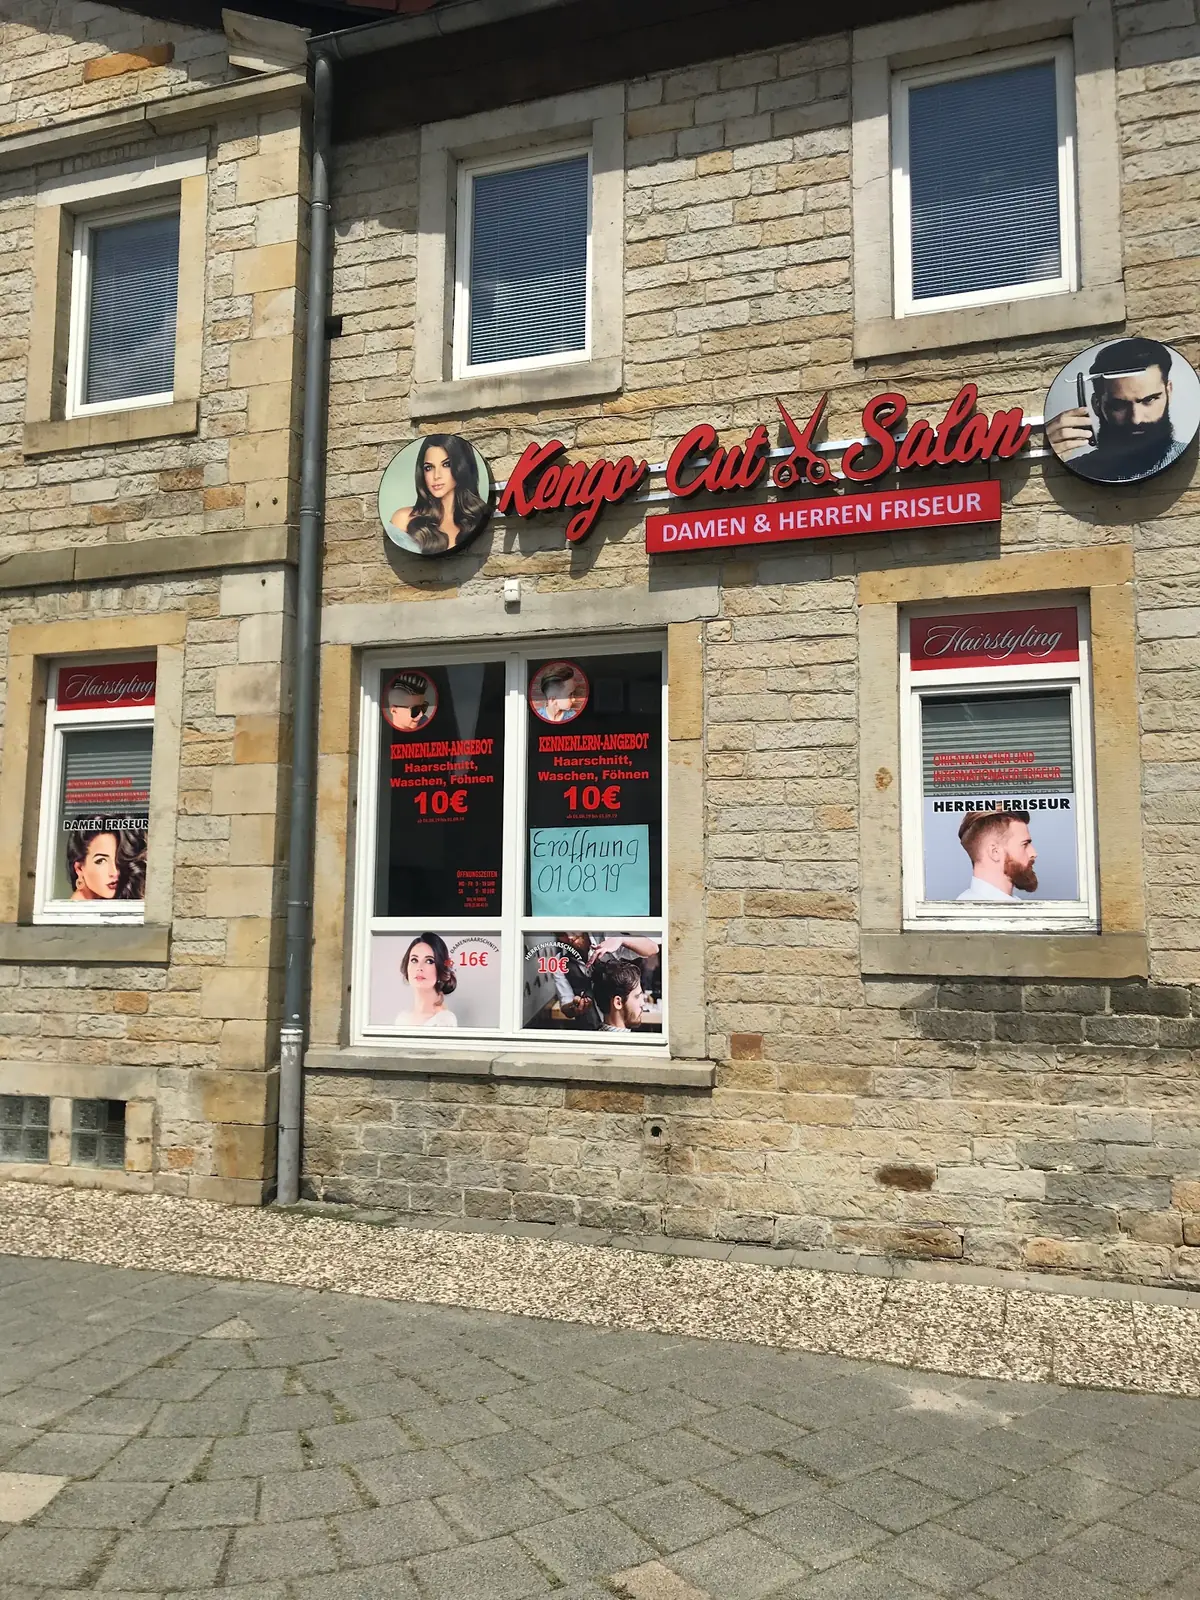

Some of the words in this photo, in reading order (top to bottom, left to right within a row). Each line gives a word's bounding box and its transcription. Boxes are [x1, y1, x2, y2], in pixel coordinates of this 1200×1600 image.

[498, 440, 648, 541] Kengo
[666, 424, 769, 497] Cut
[842, 383, 1032, 482] Salon
[663, 517, 746, 542] DAMEN
[753, 513, 771, 533] &
[779, 504, 872, 530] HERREN
[880, 493, 981, 521] FRISEUR
[924, 625, 1062, 660] Hairstyling
[66, 674, 155, 703] Hairstyling
[390, 739, 494, 759] KENNENLERN-ANGEBOT
[539, 733, 649, 752] KENNENLERN-ANGEBOT
[404, 760, 478, 773] Haarschnitt,
[553, 755, 632, 766] Haarschnitt,
[390, 776, 446, 788] Waschen,
[450, 774, 494, 785] Föhnen
[538, 771, 598, 782] Waschen,
[602, 769, 649, 780] Föhnen
[414, 790, 468, 814] 10€
[564, 785, 621, 811] 10€
[934, 800, 996, 813] HERREN
[1004, 798, 1070, 811] FRISEUR
[63, 820, 102, 831] DAMEN
[105, 819, 148, 830] FRISEUR
[450, 937, 499, 954] DAMENHAARSCHNITT
[525, 941, 582, 961] HERRENHAARSCHNITT
[460, 951, 488, 967] 16€
[538, 957, 570, 973] 10€
